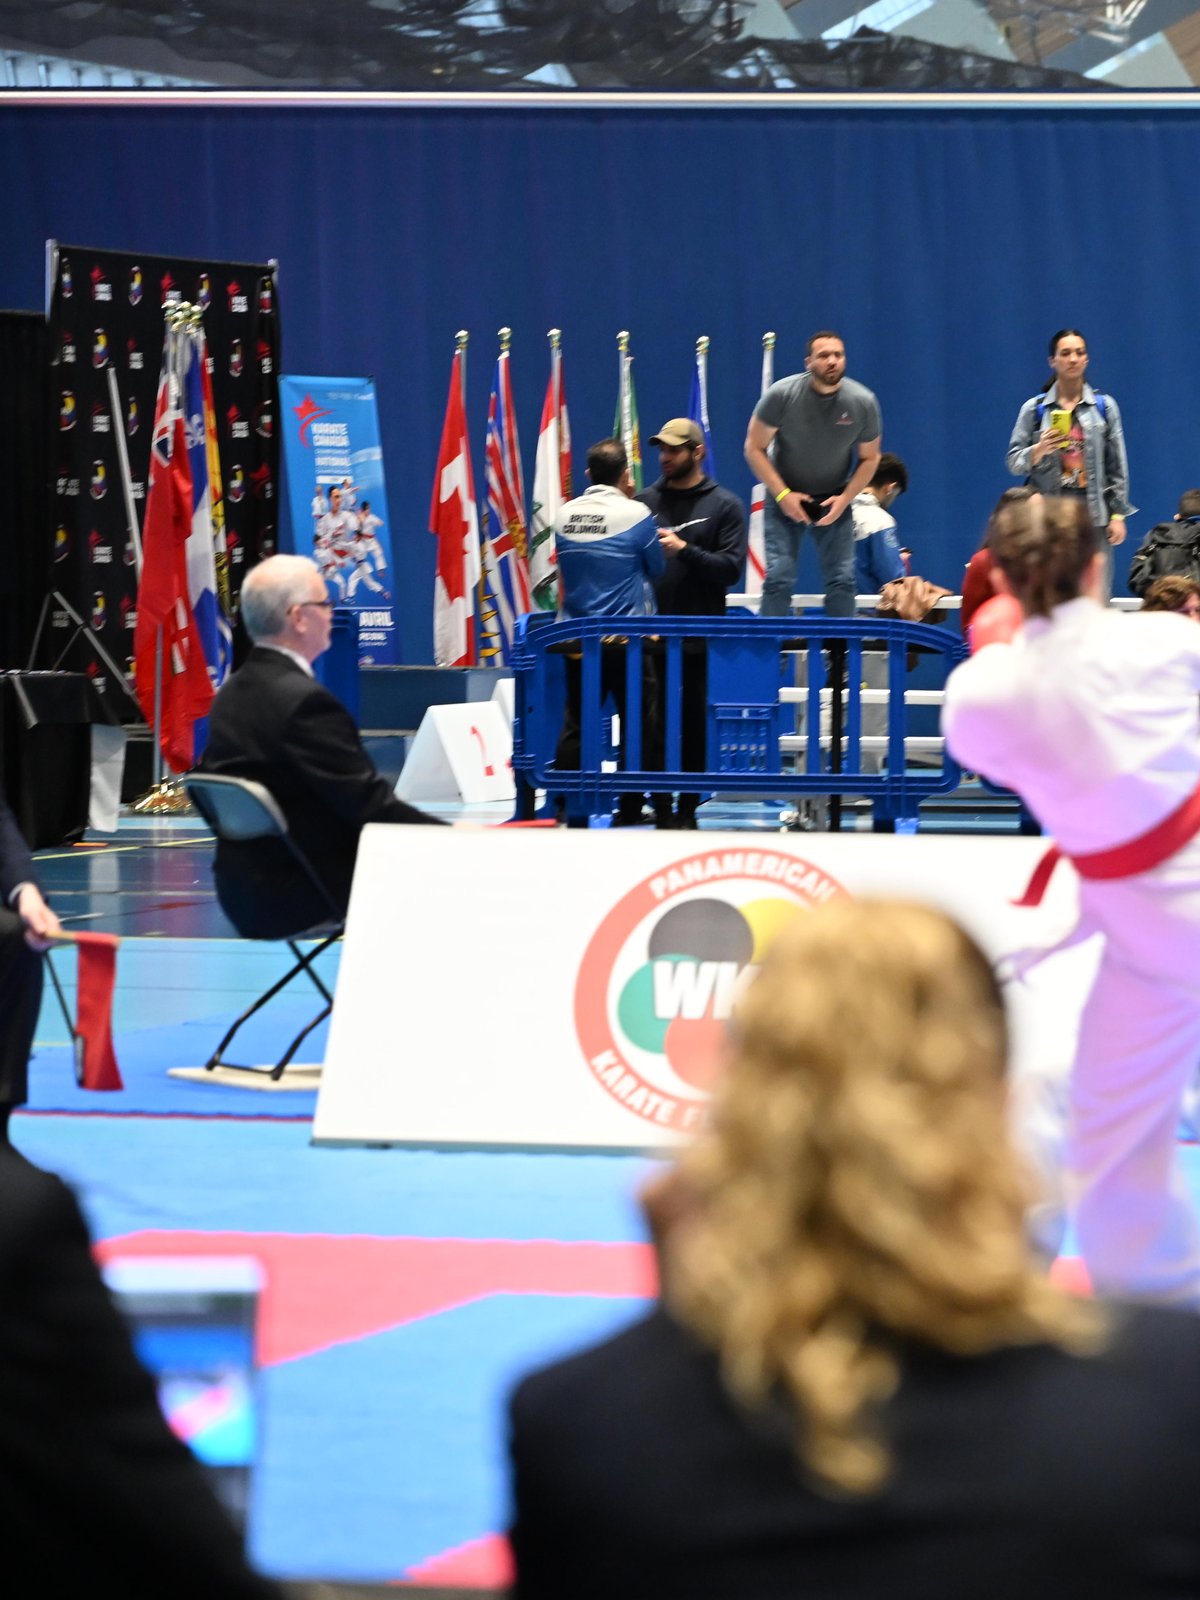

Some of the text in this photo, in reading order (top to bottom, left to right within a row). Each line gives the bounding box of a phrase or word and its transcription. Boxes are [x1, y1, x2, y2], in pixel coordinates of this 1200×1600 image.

[563, 524, 608, 535] COLUMBIA
[569, 514, 606, 523] BRITISH
[649, 852, 838, 901] PANAMERICAN
[591, 1049, 677, 1124] KARATE
